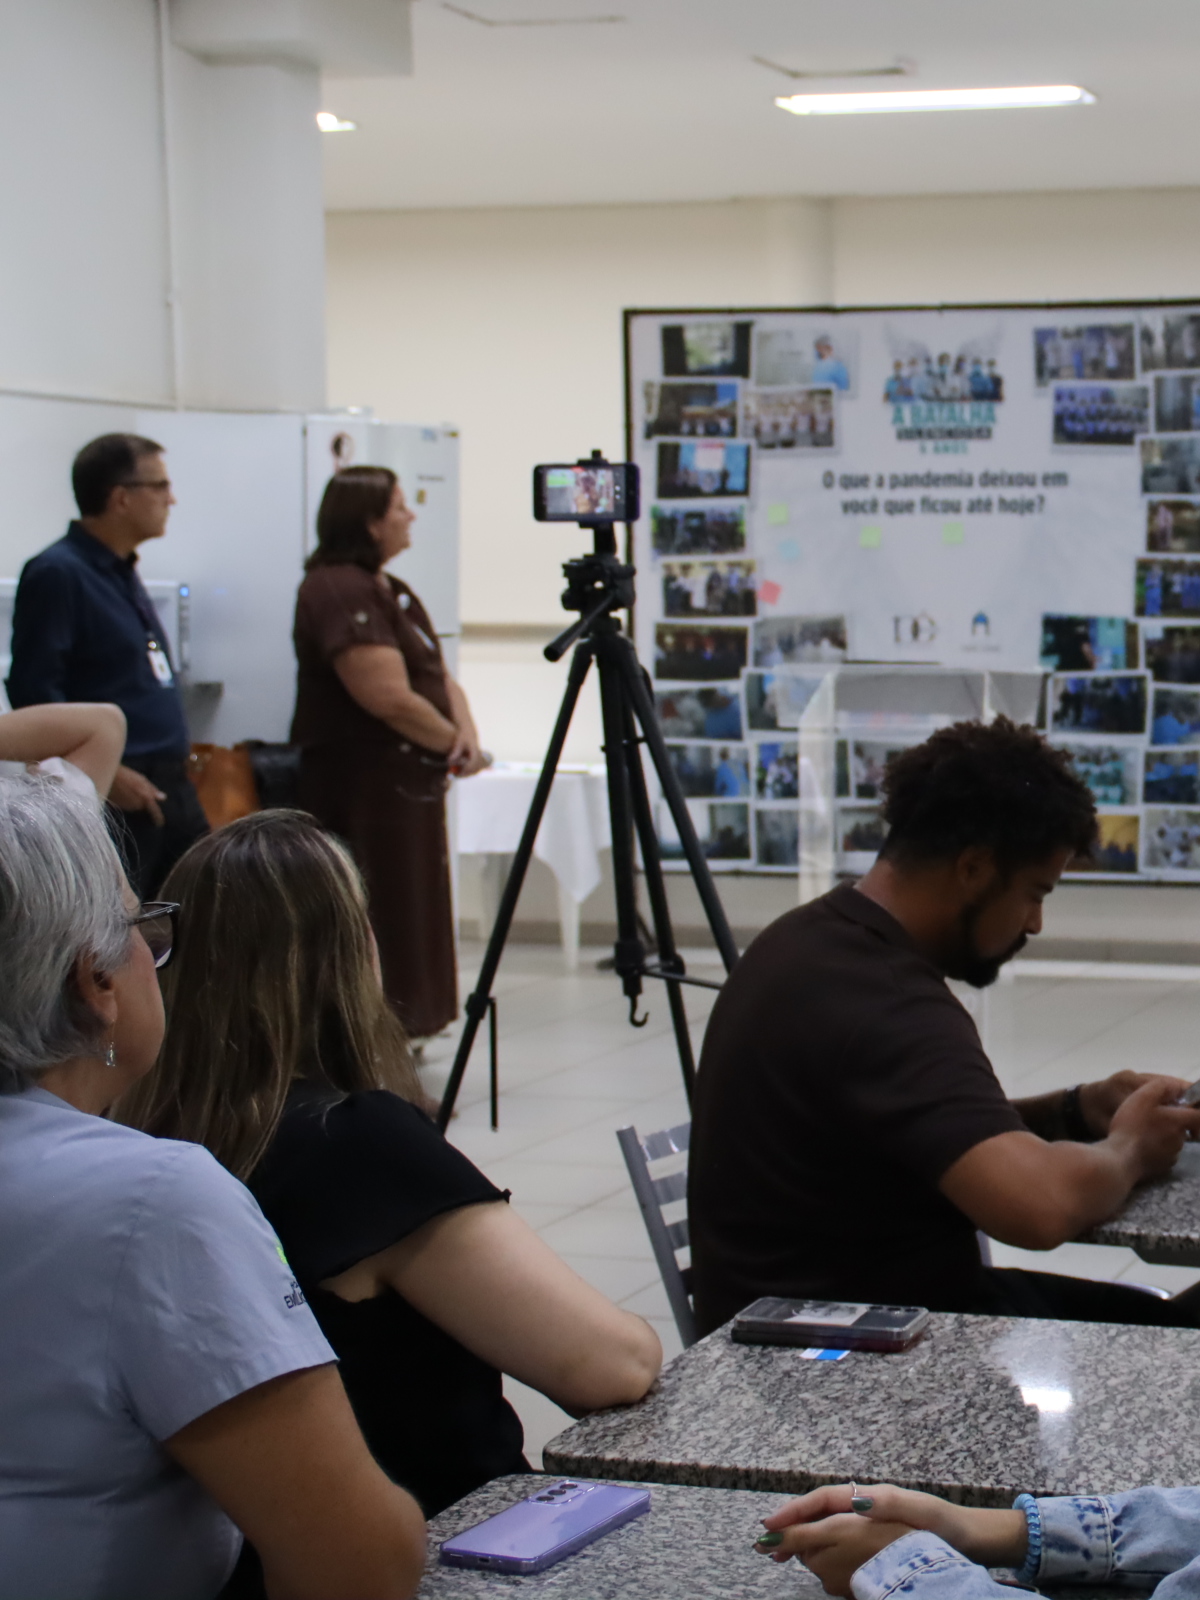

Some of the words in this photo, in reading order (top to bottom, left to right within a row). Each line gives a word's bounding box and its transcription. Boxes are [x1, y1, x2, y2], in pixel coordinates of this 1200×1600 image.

[892, 404, 905, 424] A
[910, 402, 996, 424] BATALHA
[822, 470, 835, 489] O
[839, 473, 870, 490] que
[876, 474, 885, 488] a
[889, 468, 974, 490] pandemia
[979, 468, 1036, 488] deixou
[1042, 472, 1068, 488] em
[841, 496, 879, 514] você
[884, 499, 915, 516] que
[920, 495, 962, 514] ficou
[966, 495, 993, 514] até
[998, 494, 1046, 517] hoje?
